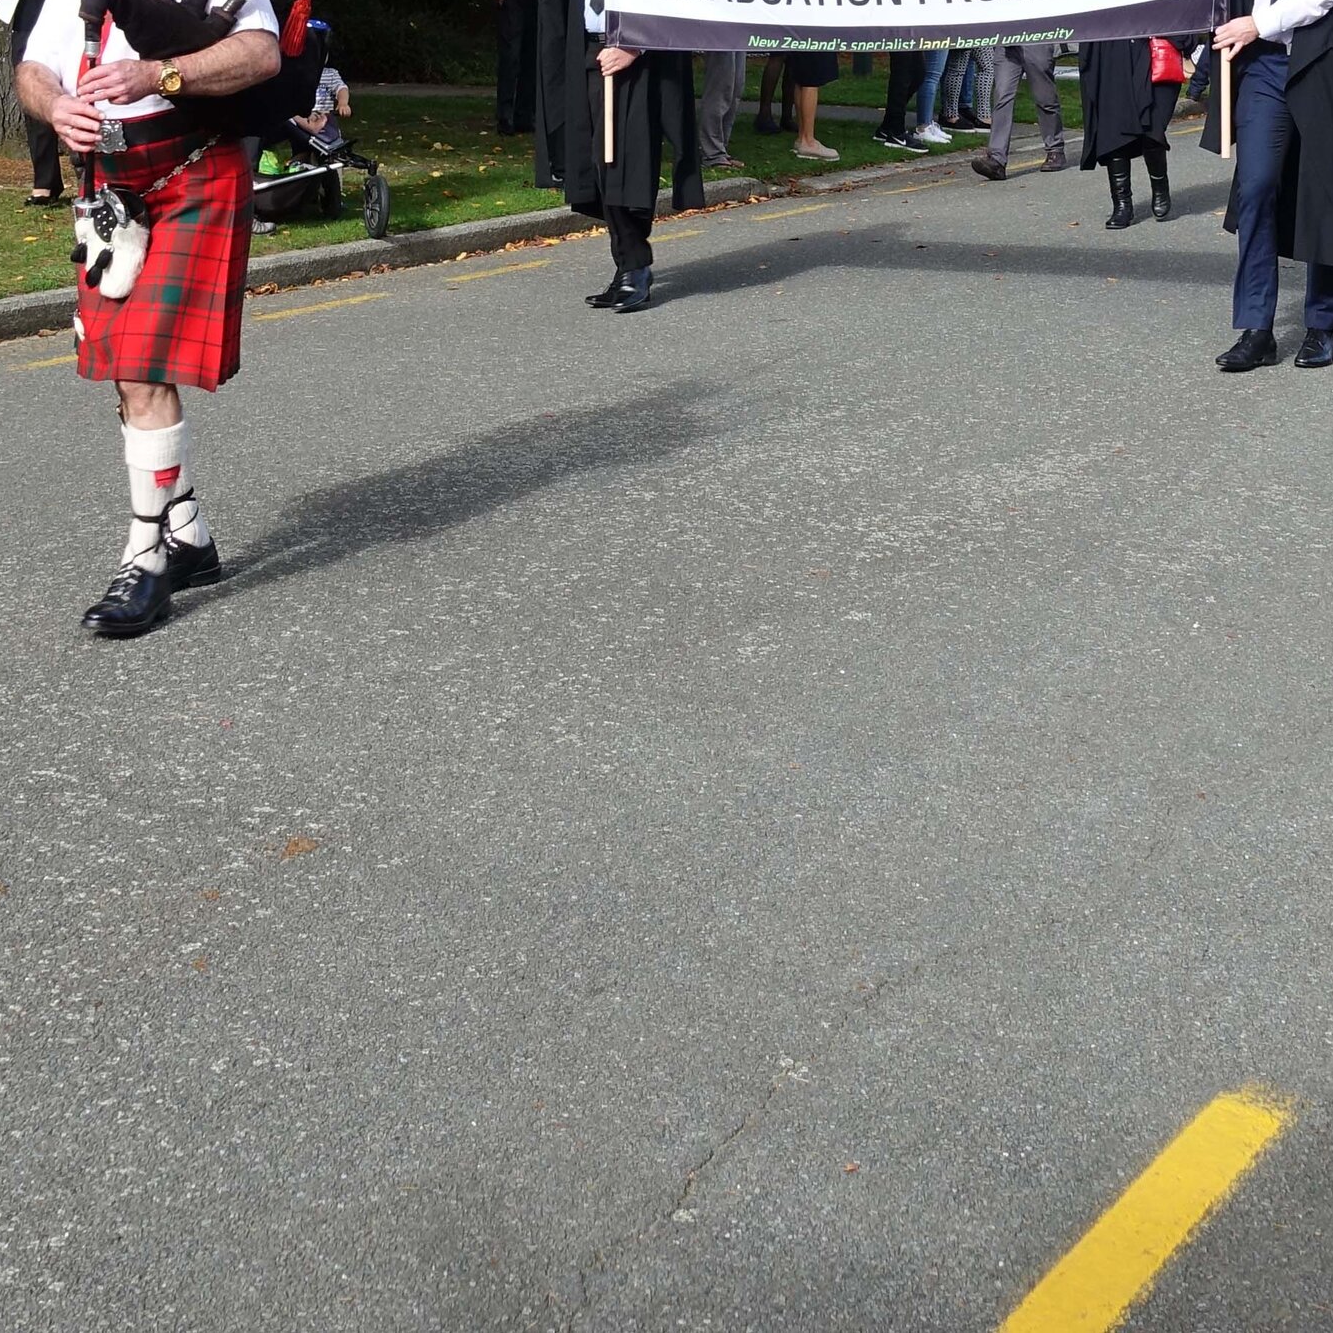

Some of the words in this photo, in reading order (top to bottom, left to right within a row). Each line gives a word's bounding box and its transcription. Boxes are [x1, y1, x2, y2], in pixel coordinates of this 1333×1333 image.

[748, 35, 779, 48] New
[781, 37, 847, 51] Zealand's
[919, 33, 1000, 49] land-based
[1001, 27, 1074, 45] university
